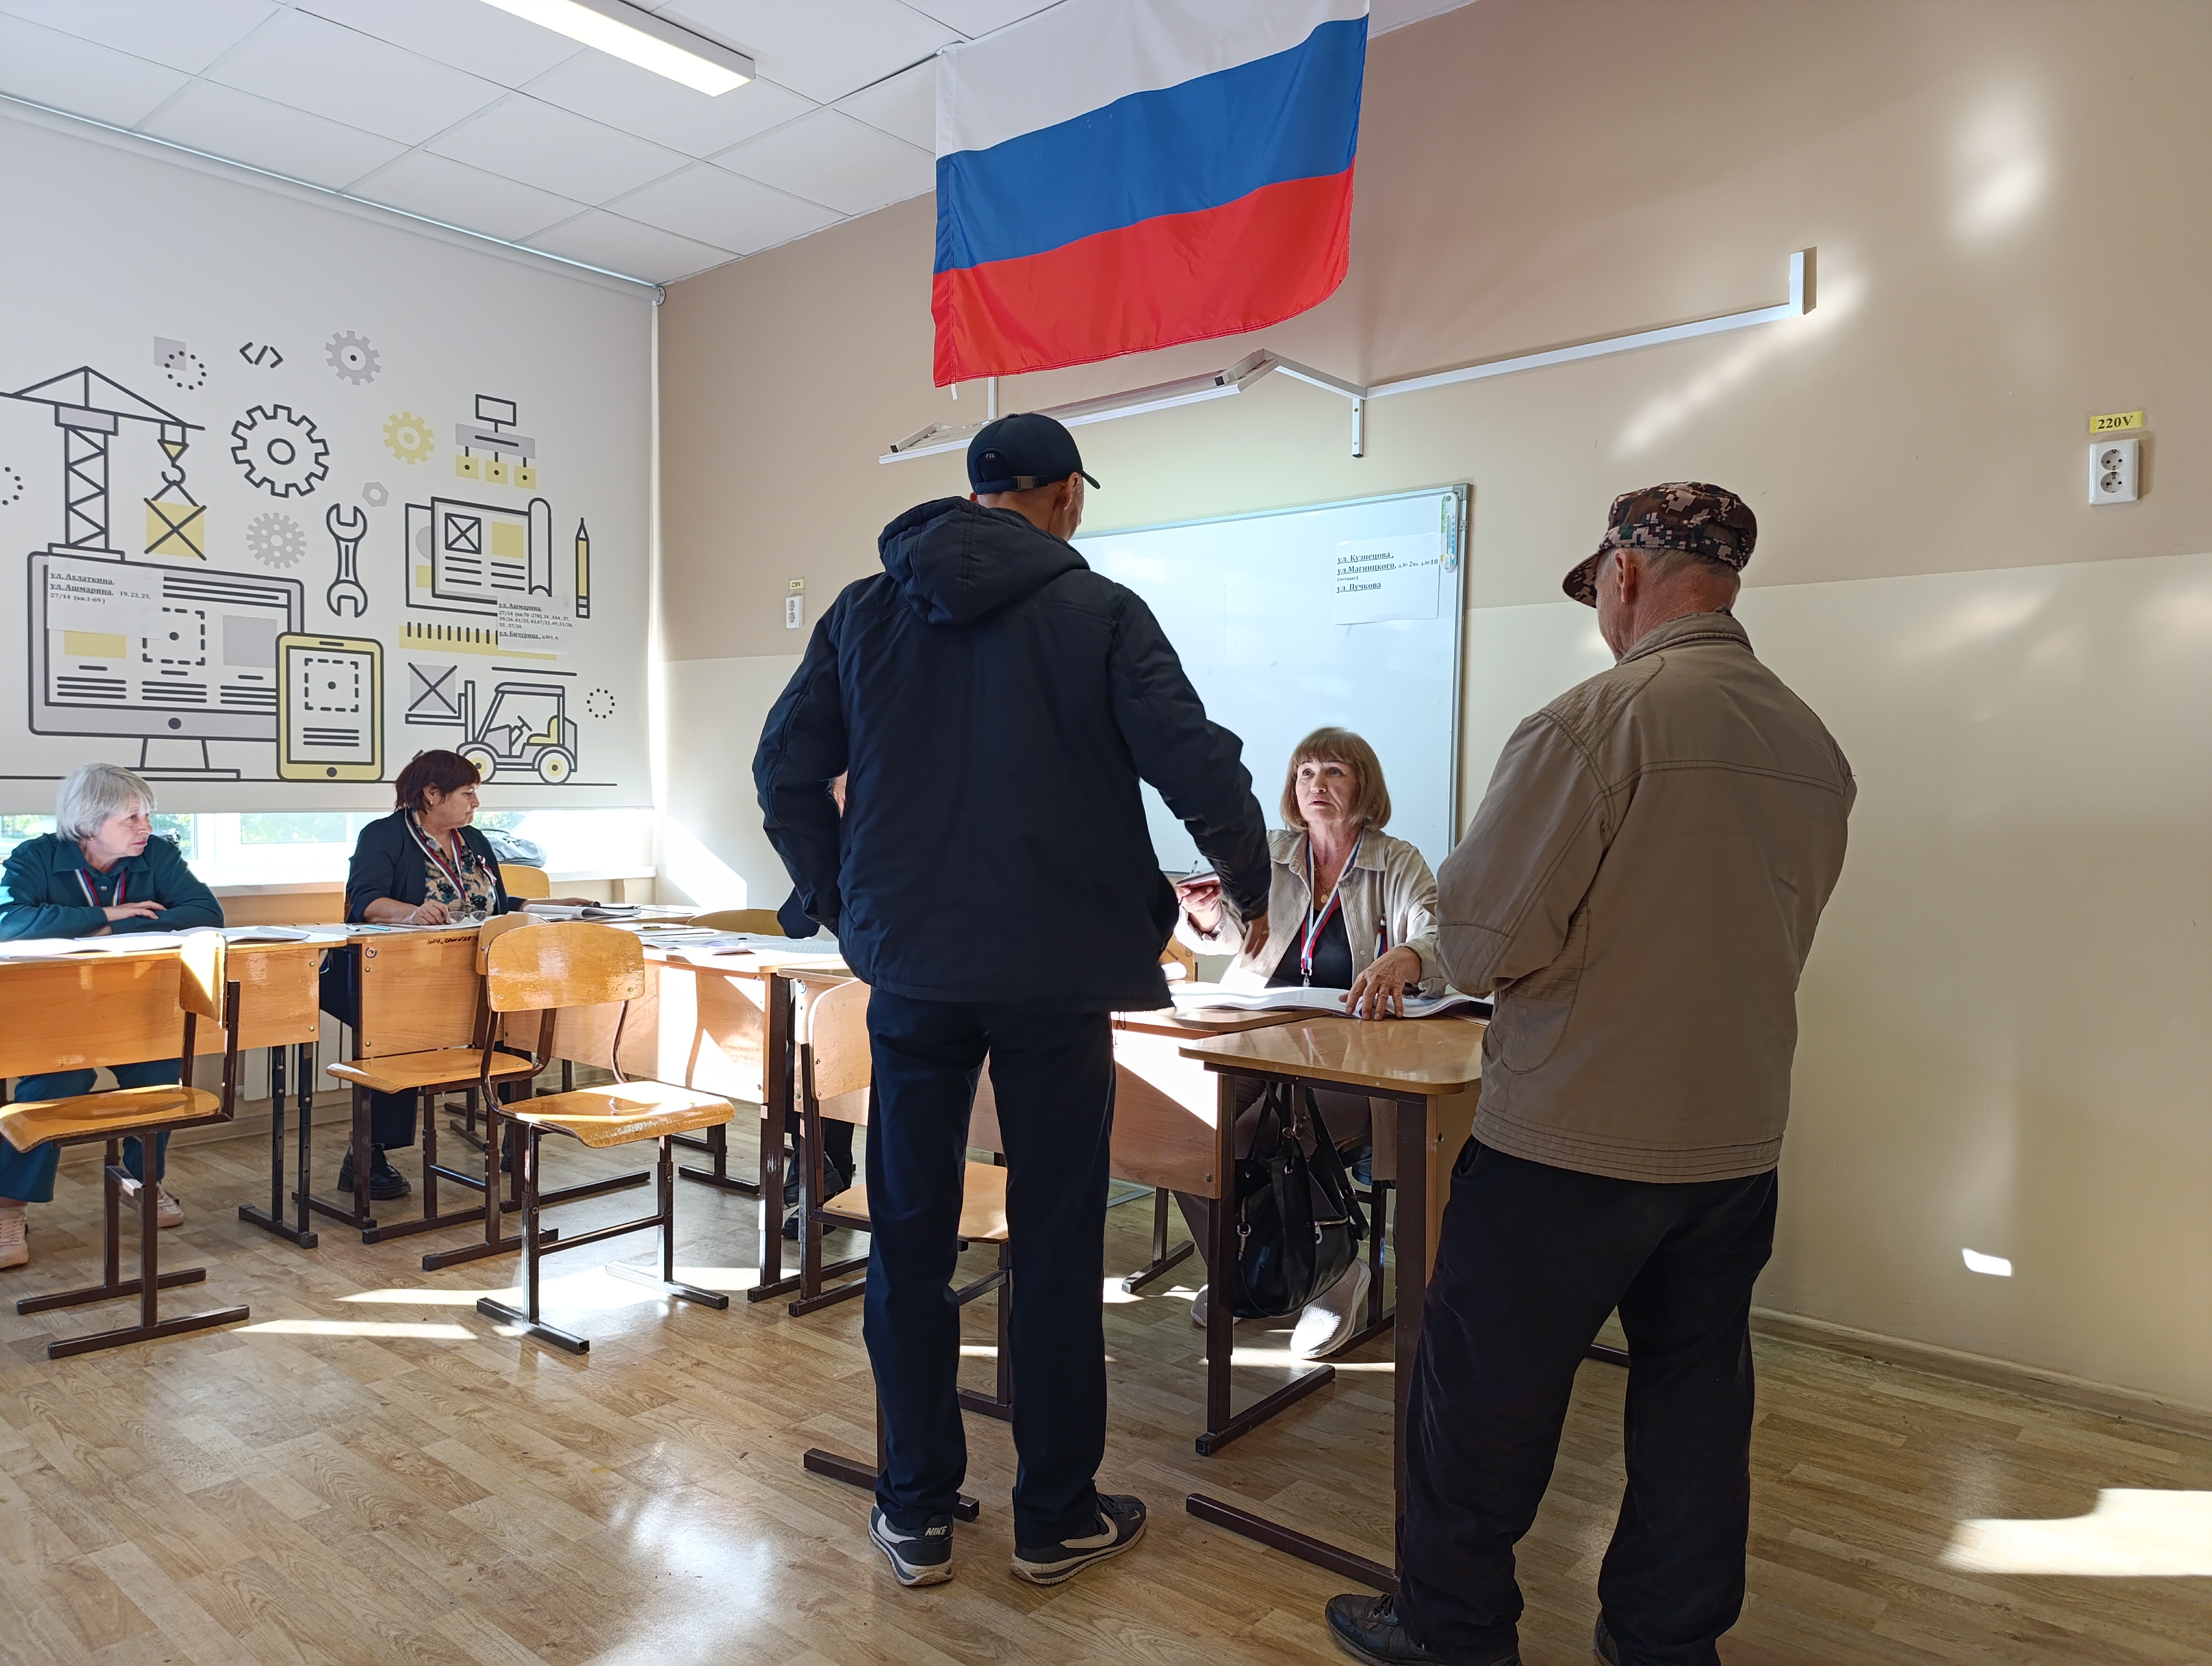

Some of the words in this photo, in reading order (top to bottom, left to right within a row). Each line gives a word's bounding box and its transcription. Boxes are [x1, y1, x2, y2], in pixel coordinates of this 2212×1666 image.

[2098, 415, 2133, 429] 220V
[66, 573, 115, 585] Ахлаткина,
[66, 584, 114, 595] Ашмарина,
[1349, 582, 1381, 592] Пучкова
[509, 603, 542, 611] Ашмарина,
[924, 1526, 947, 1536] NIKE
